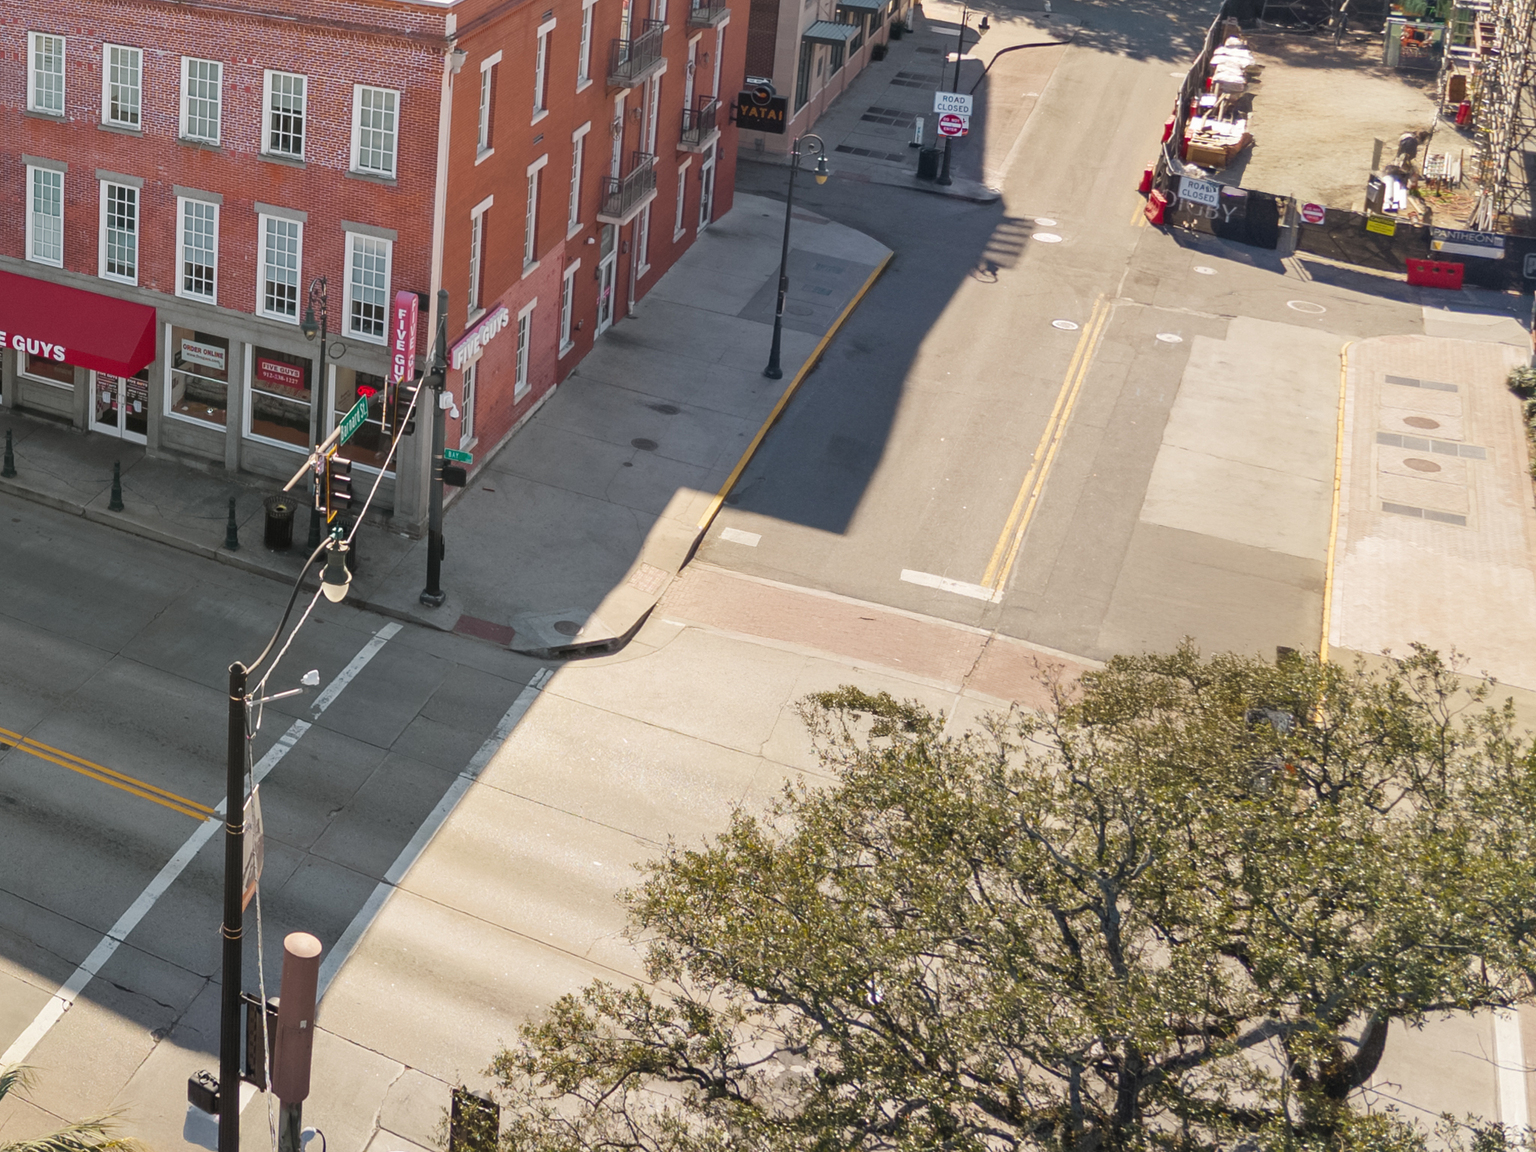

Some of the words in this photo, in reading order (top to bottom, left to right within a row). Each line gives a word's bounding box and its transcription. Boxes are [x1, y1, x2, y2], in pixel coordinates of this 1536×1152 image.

[937, 103, 969, 113] CLOSED
[942, 95, 966, 104] ROAD
[740, 104, 783, 121] YATAI
[1182, 188, 1215, 203] CLOSED
[1434, 229, 1494, 244] PANTHEON
[396, 308, 407, 351] FIVE
[409, 297, 417, 350] FIVE
[453, 332, 481, 370] FIVE
[479, 307, 509, 346] GUYS
[12, 334, 66, 362] GUYS
[183, 343, 202, 354] ORDER
[203, 348, 223, 359] ONLINE
[263, 363, 278, 372] FIVE
[279, 367, 299, 377] GUYS
[394, 354, 405, 383] GUY
[407, 354, 415, 382] GU
[340, 407, 360, 442] Barnard
[448, 450, 459, 459] BAY
